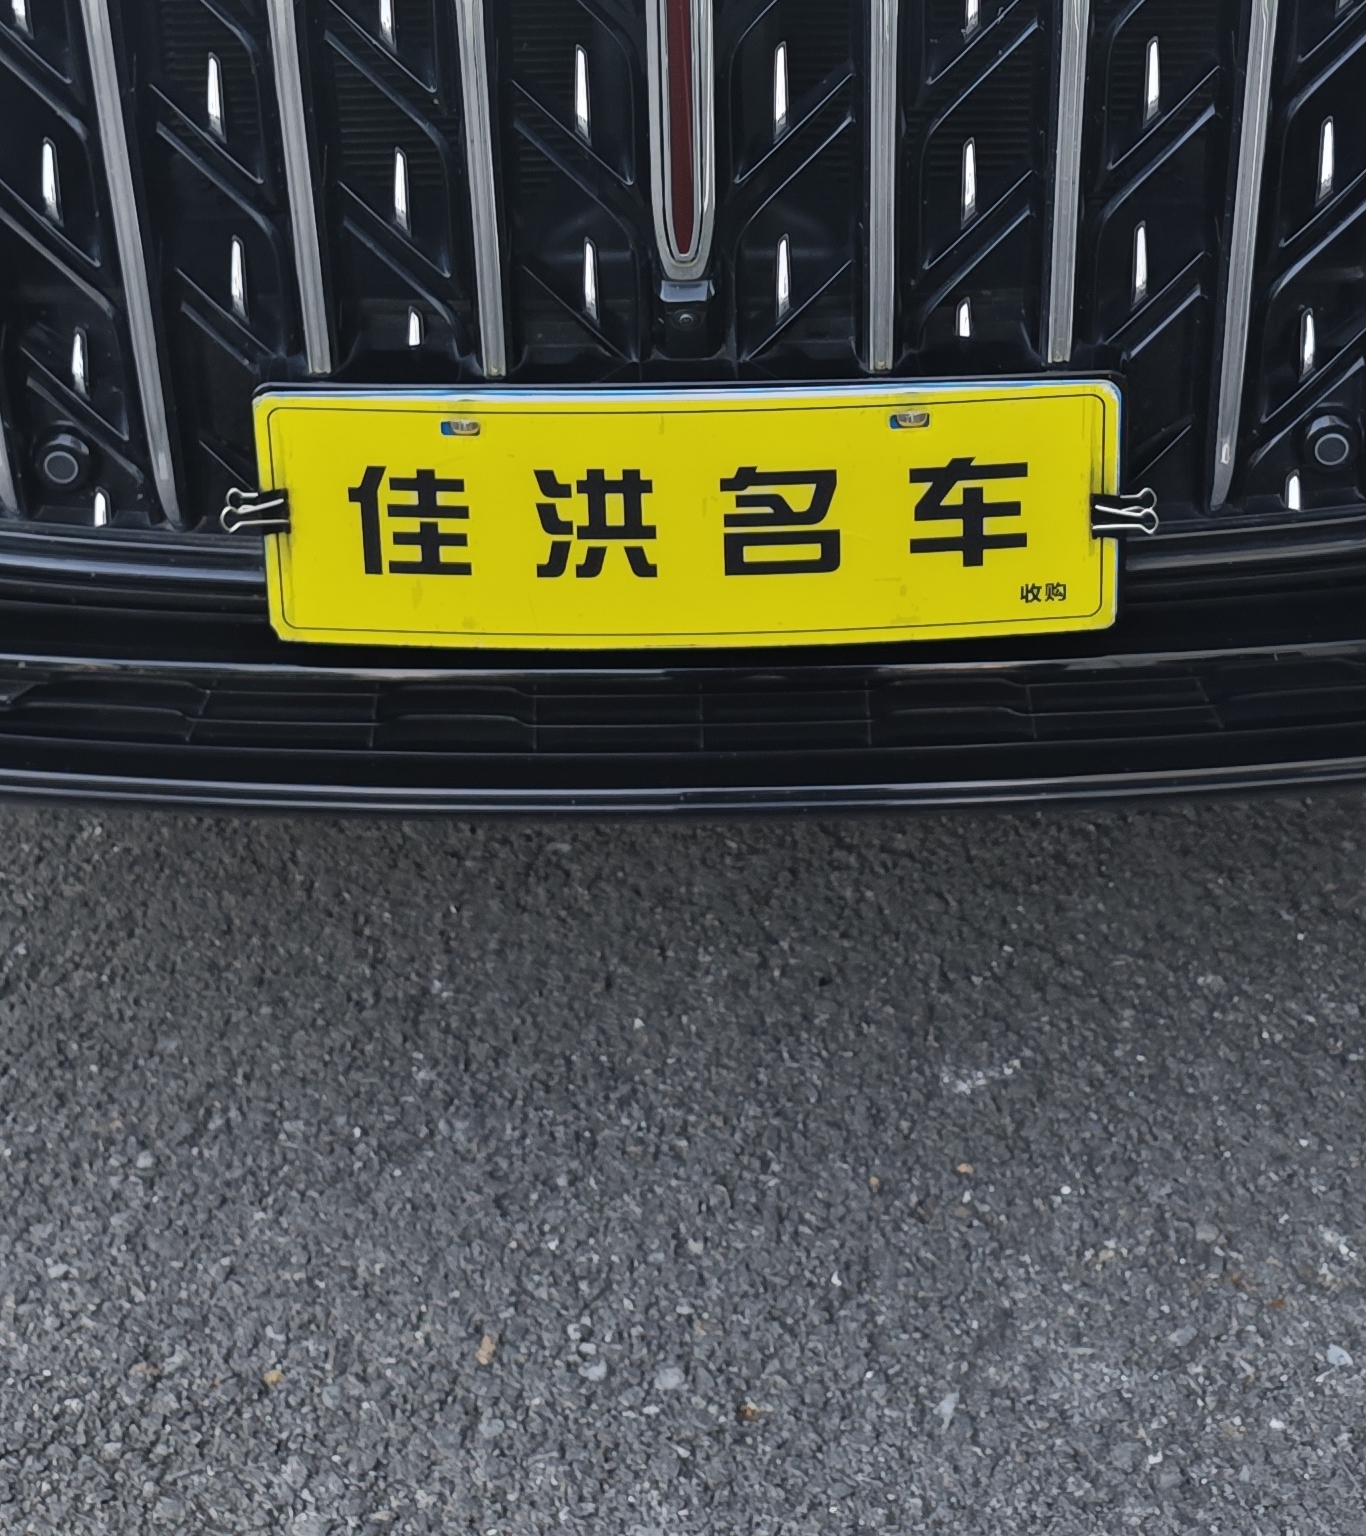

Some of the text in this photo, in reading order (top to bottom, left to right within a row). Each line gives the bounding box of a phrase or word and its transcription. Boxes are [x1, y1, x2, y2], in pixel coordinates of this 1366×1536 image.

[348, 457, 1029, 578] 佳洪名车
[1020, 582, 1066, 603] 收购
